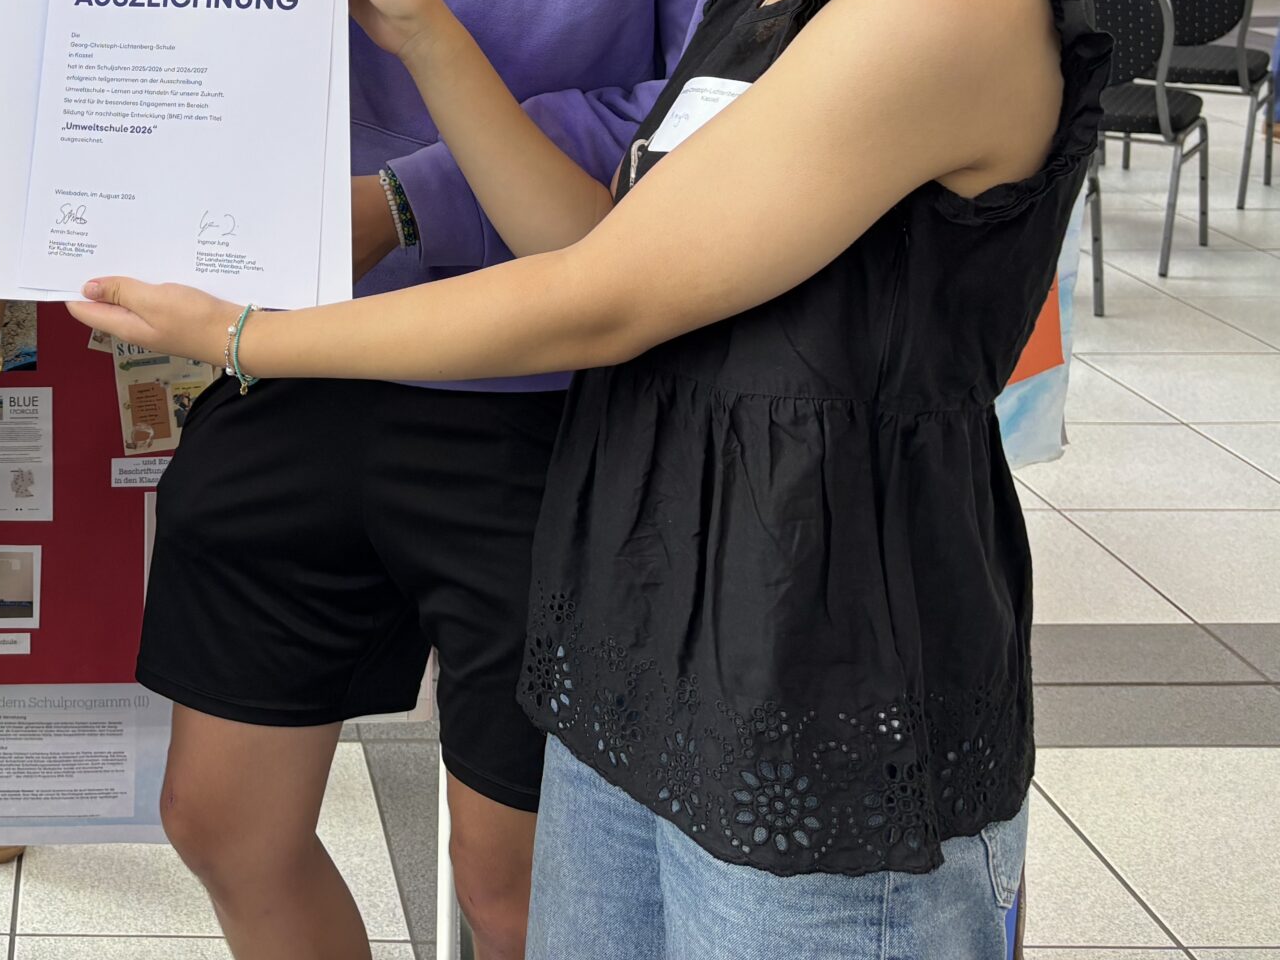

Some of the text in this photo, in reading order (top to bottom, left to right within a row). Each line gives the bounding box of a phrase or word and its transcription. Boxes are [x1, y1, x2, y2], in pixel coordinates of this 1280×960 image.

[9, 396, 39, 407] BLUE
[28, 695, 132, 710] Schulprogramm
[133, 695, 151, 709] (II)
